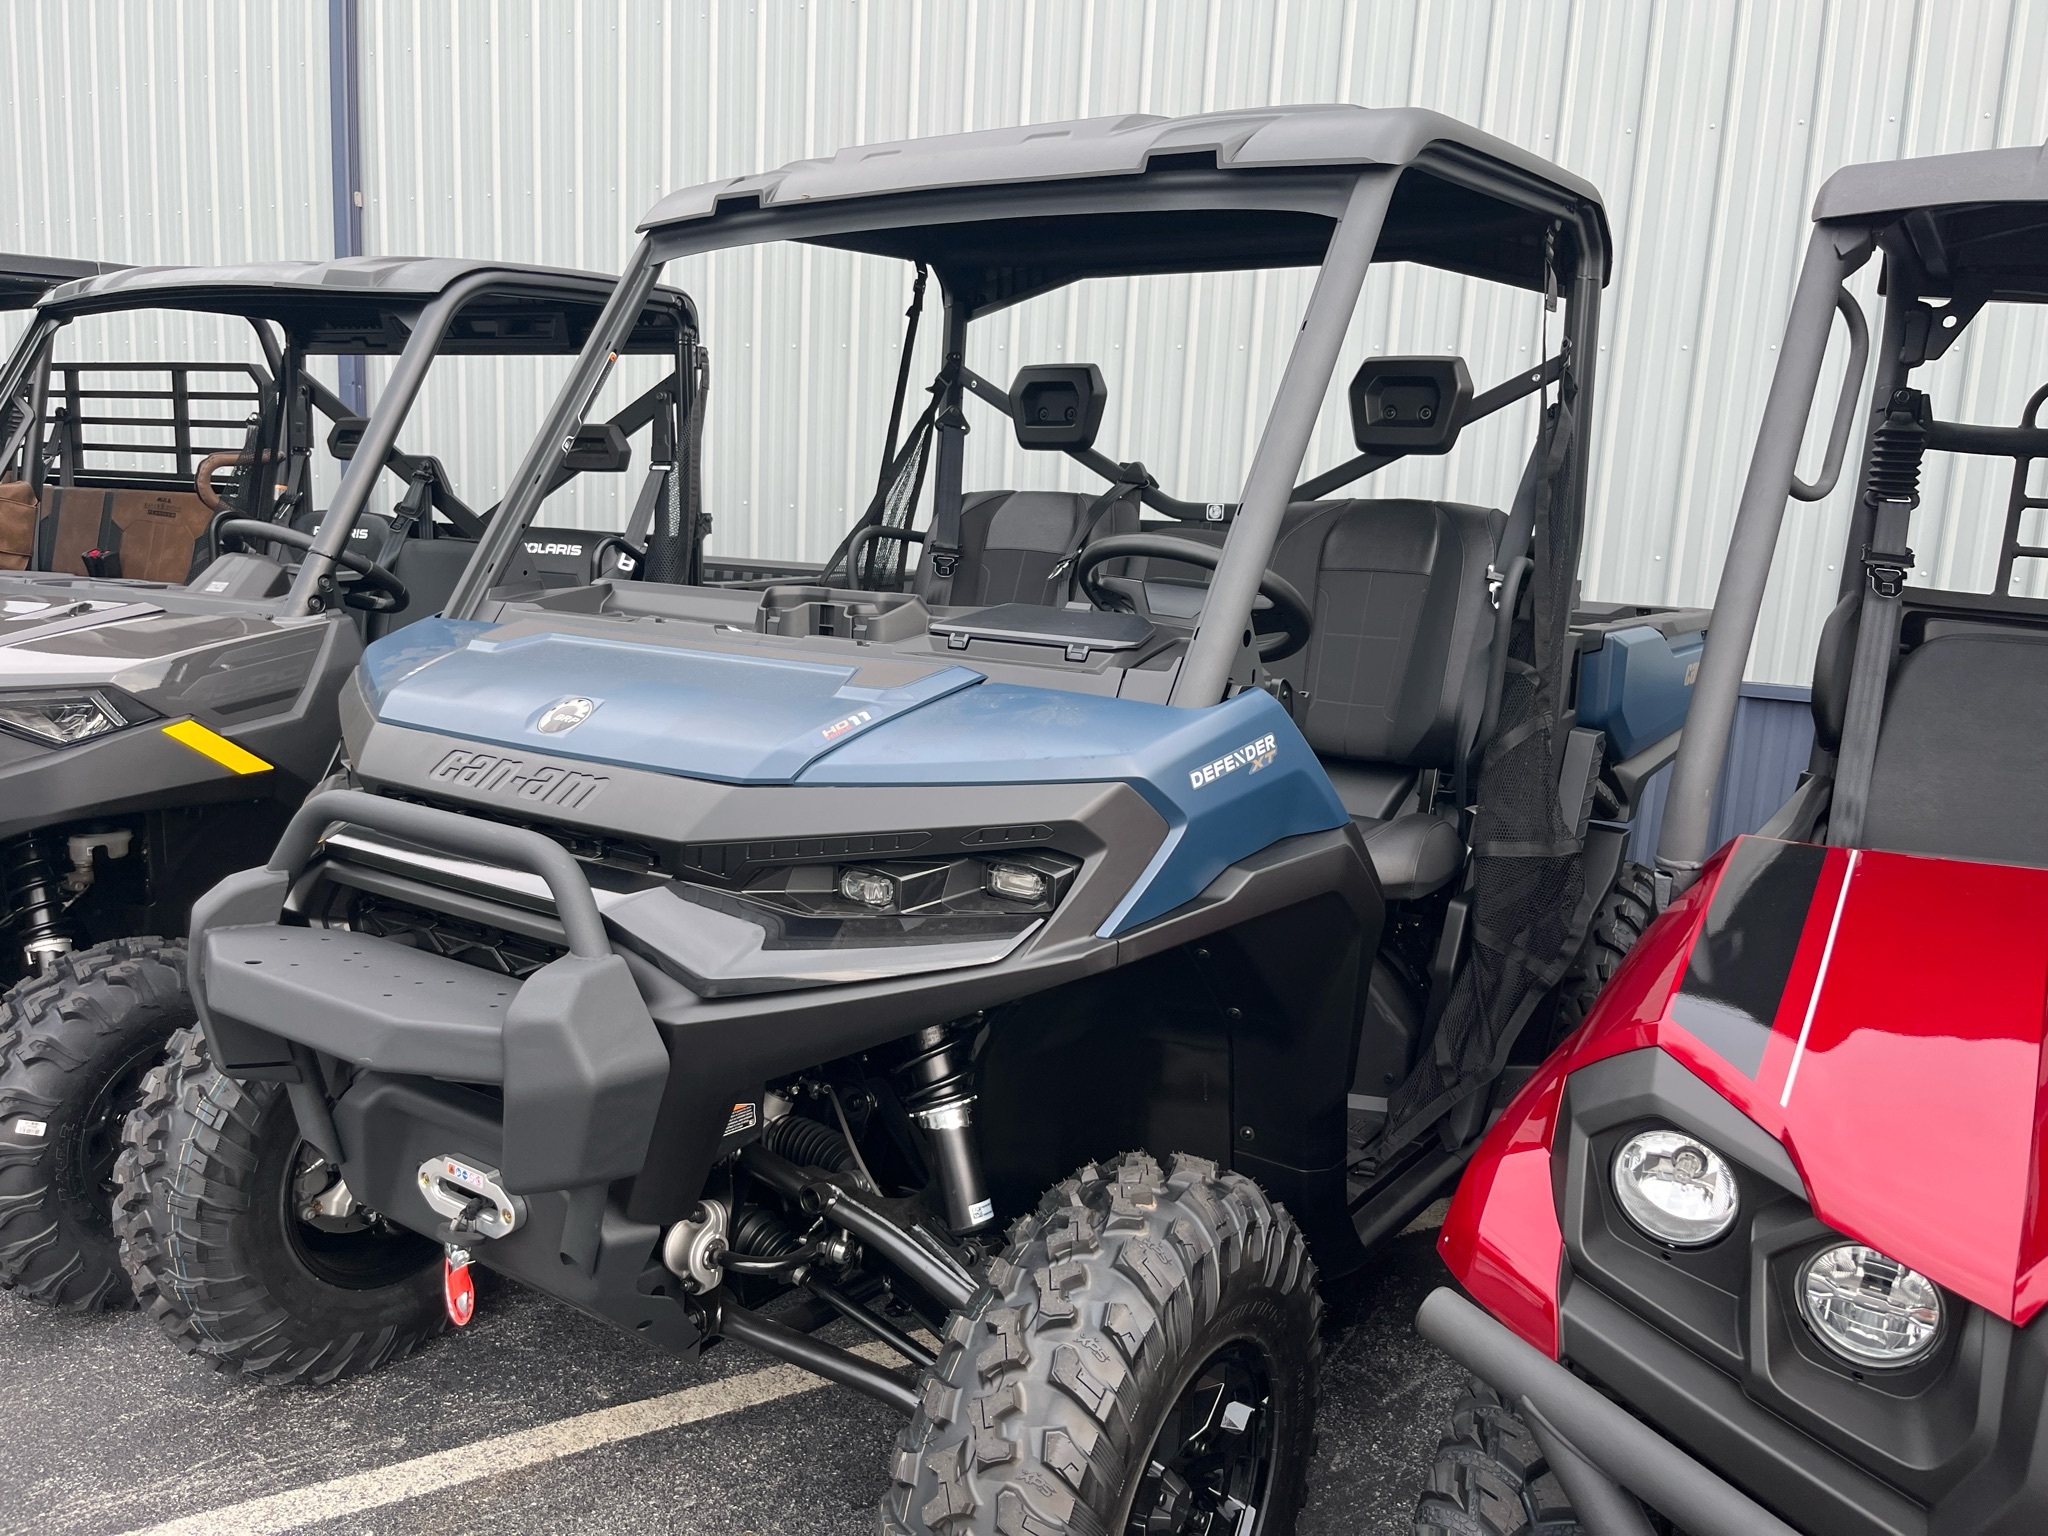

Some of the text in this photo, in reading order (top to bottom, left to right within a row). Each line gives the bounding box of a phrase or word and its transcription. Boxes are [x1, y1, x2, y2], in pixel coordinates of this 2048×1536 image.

[313, 525, 369, 539] PRIS
[524, 542, 583, 556] OLARIS
[554, 713, 581, 723] BRP
[1190, 734, 1276, 789] DEFENDER
[1251, 749, 1277, 773] XT
